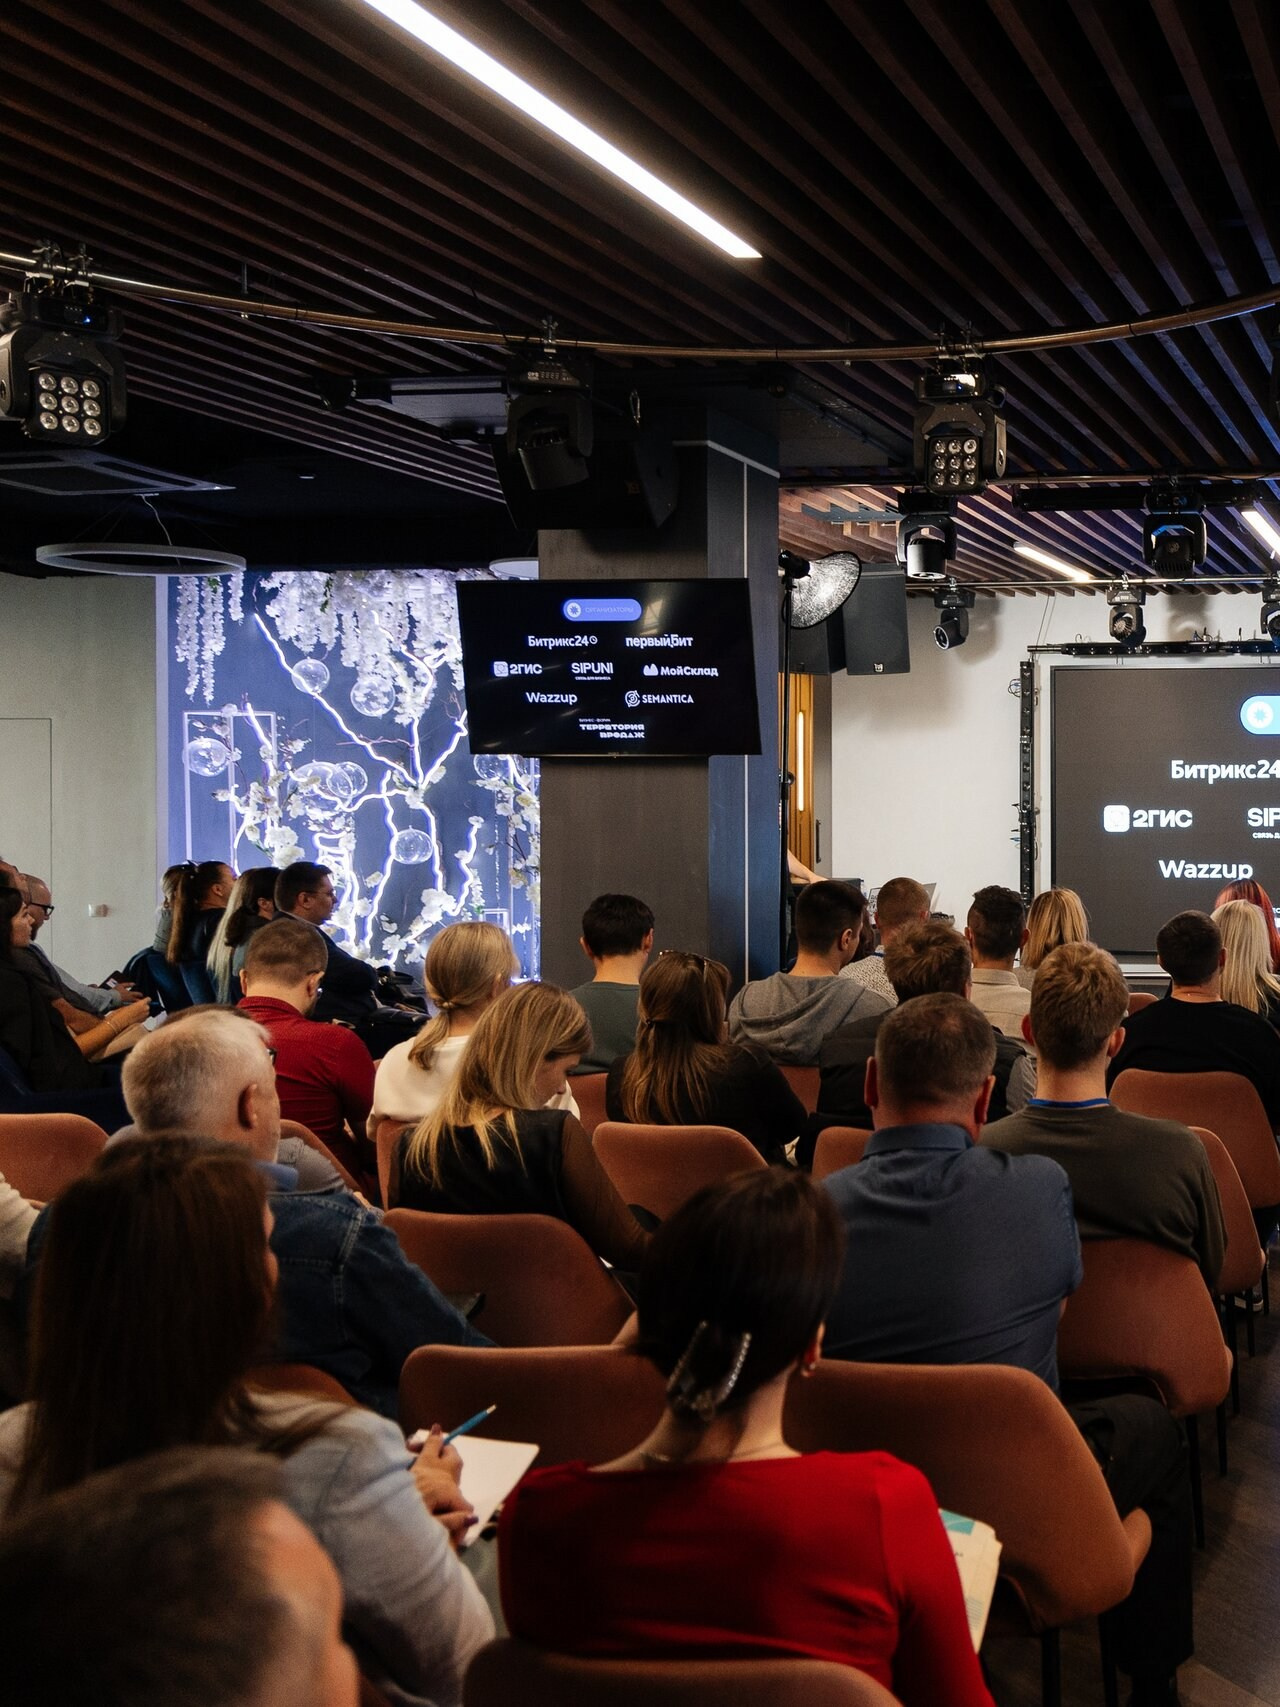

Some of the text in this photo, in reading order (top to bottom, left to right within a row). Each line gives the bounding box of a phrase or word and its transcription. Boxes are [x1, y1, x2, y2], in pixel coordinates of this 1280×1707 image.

[527, 635, 590, 650] Битрикс24
[509, 663, 543, 675] 2ГИС
[571, 662, 614, 674] SIPUNI
[660, 665, 719, 677] МойСклад
[525, 691, 578, 705] Wazzup
[641, 694, 695, 704] SEMANTICA
[1132, 809, 1193, 828] 2ГИС
[1158, 860, 1253, 879] Wazzup
